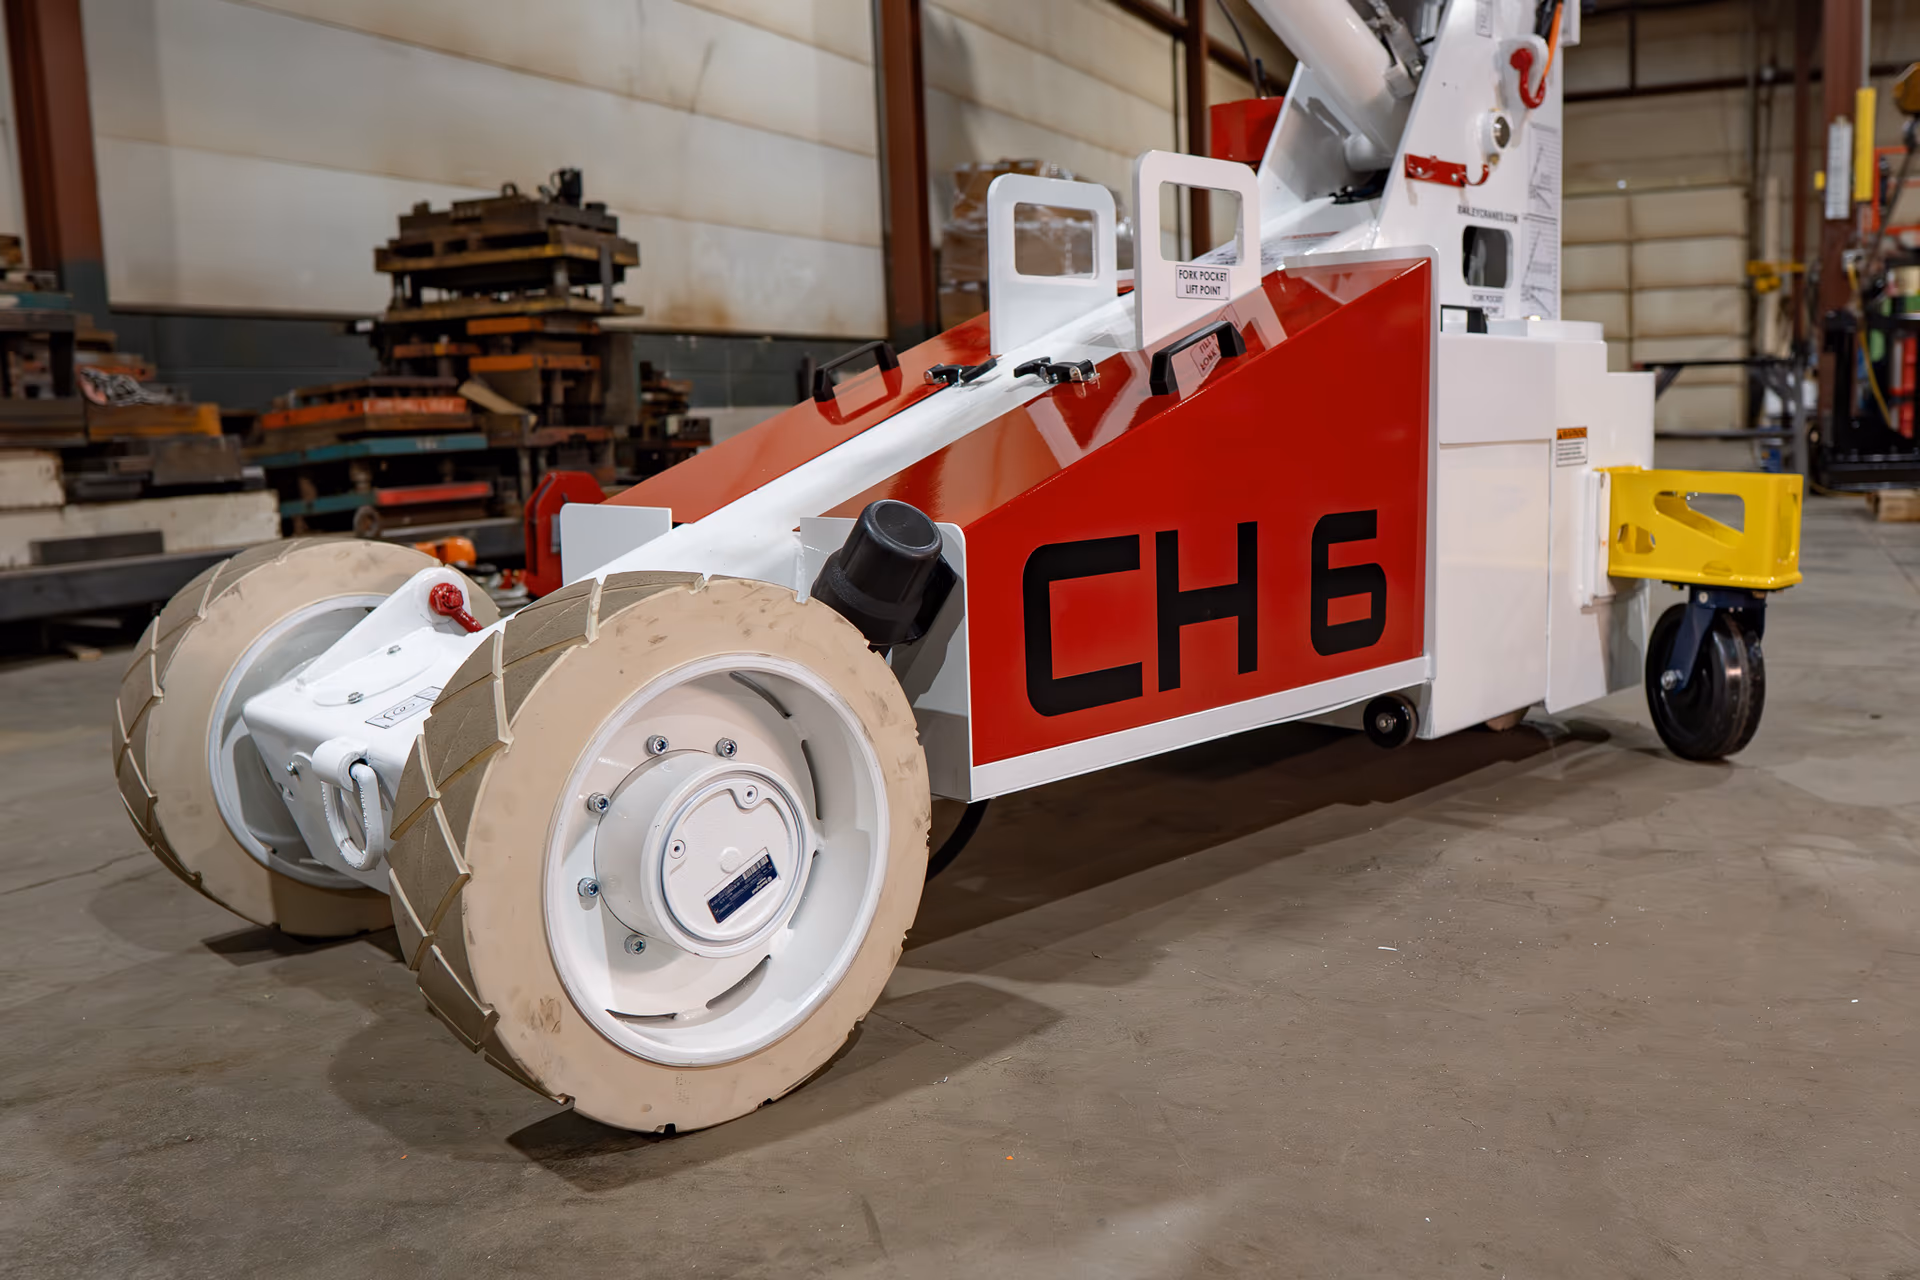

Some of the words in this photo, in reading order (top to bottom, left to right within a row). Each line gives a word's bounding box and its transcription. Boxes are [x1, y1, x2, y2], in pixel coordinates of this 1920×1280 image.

[1178, 269, 1198, 280] FORK
[1199, 271, 1227, 282] POCKET
[1185, 284, 1198, 294] LIFT
[1200, 285, 1221, 295] POINT
[1022, 520, 1258, 717] CH
[1310, 509, 1387, 656] 6
